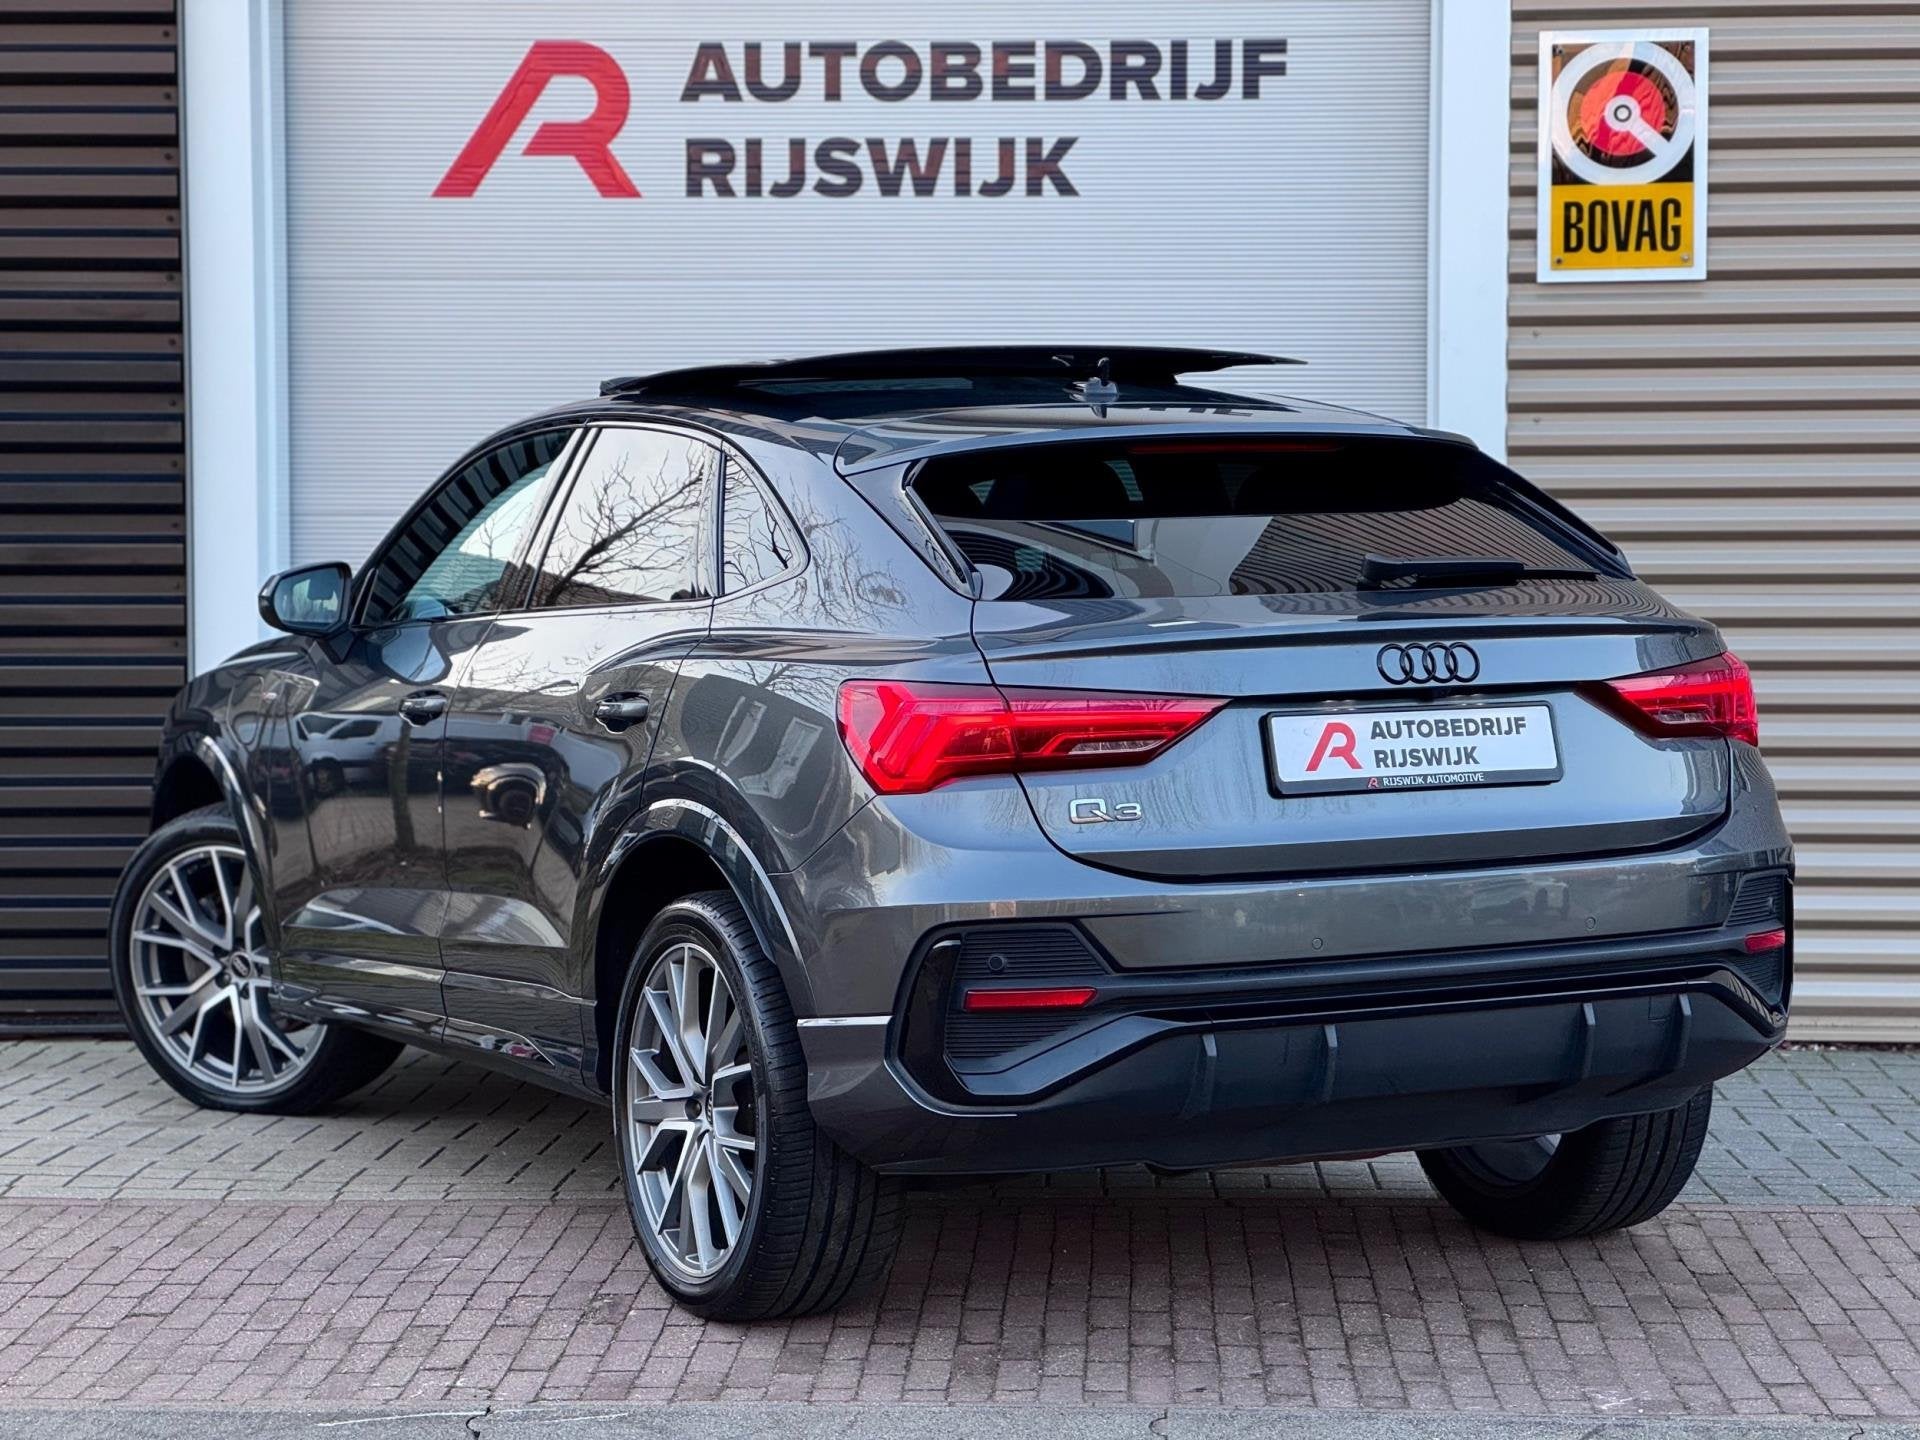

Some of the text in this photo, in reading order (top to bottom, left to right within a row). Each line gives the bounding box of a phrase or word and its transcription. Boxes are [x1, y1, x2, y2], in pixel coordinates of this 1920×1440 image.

[680, 39, 1289, 102] AUTOBEDRIJF
[685, 137, 1080, 198] RIJSWIJK
[1563, 198, 1682, 253] BOVAG
[1370, 716, 1527, 740] AUTOBEDRIJF
[1374, 746, 1480, 769] RIJSWIJK
[1383, 775, 1425, 786] RIJSWIJK
[1427, 772, 1484, 784] AUTOMOTIVE
[1069, 798, 1142, 824] Q3
